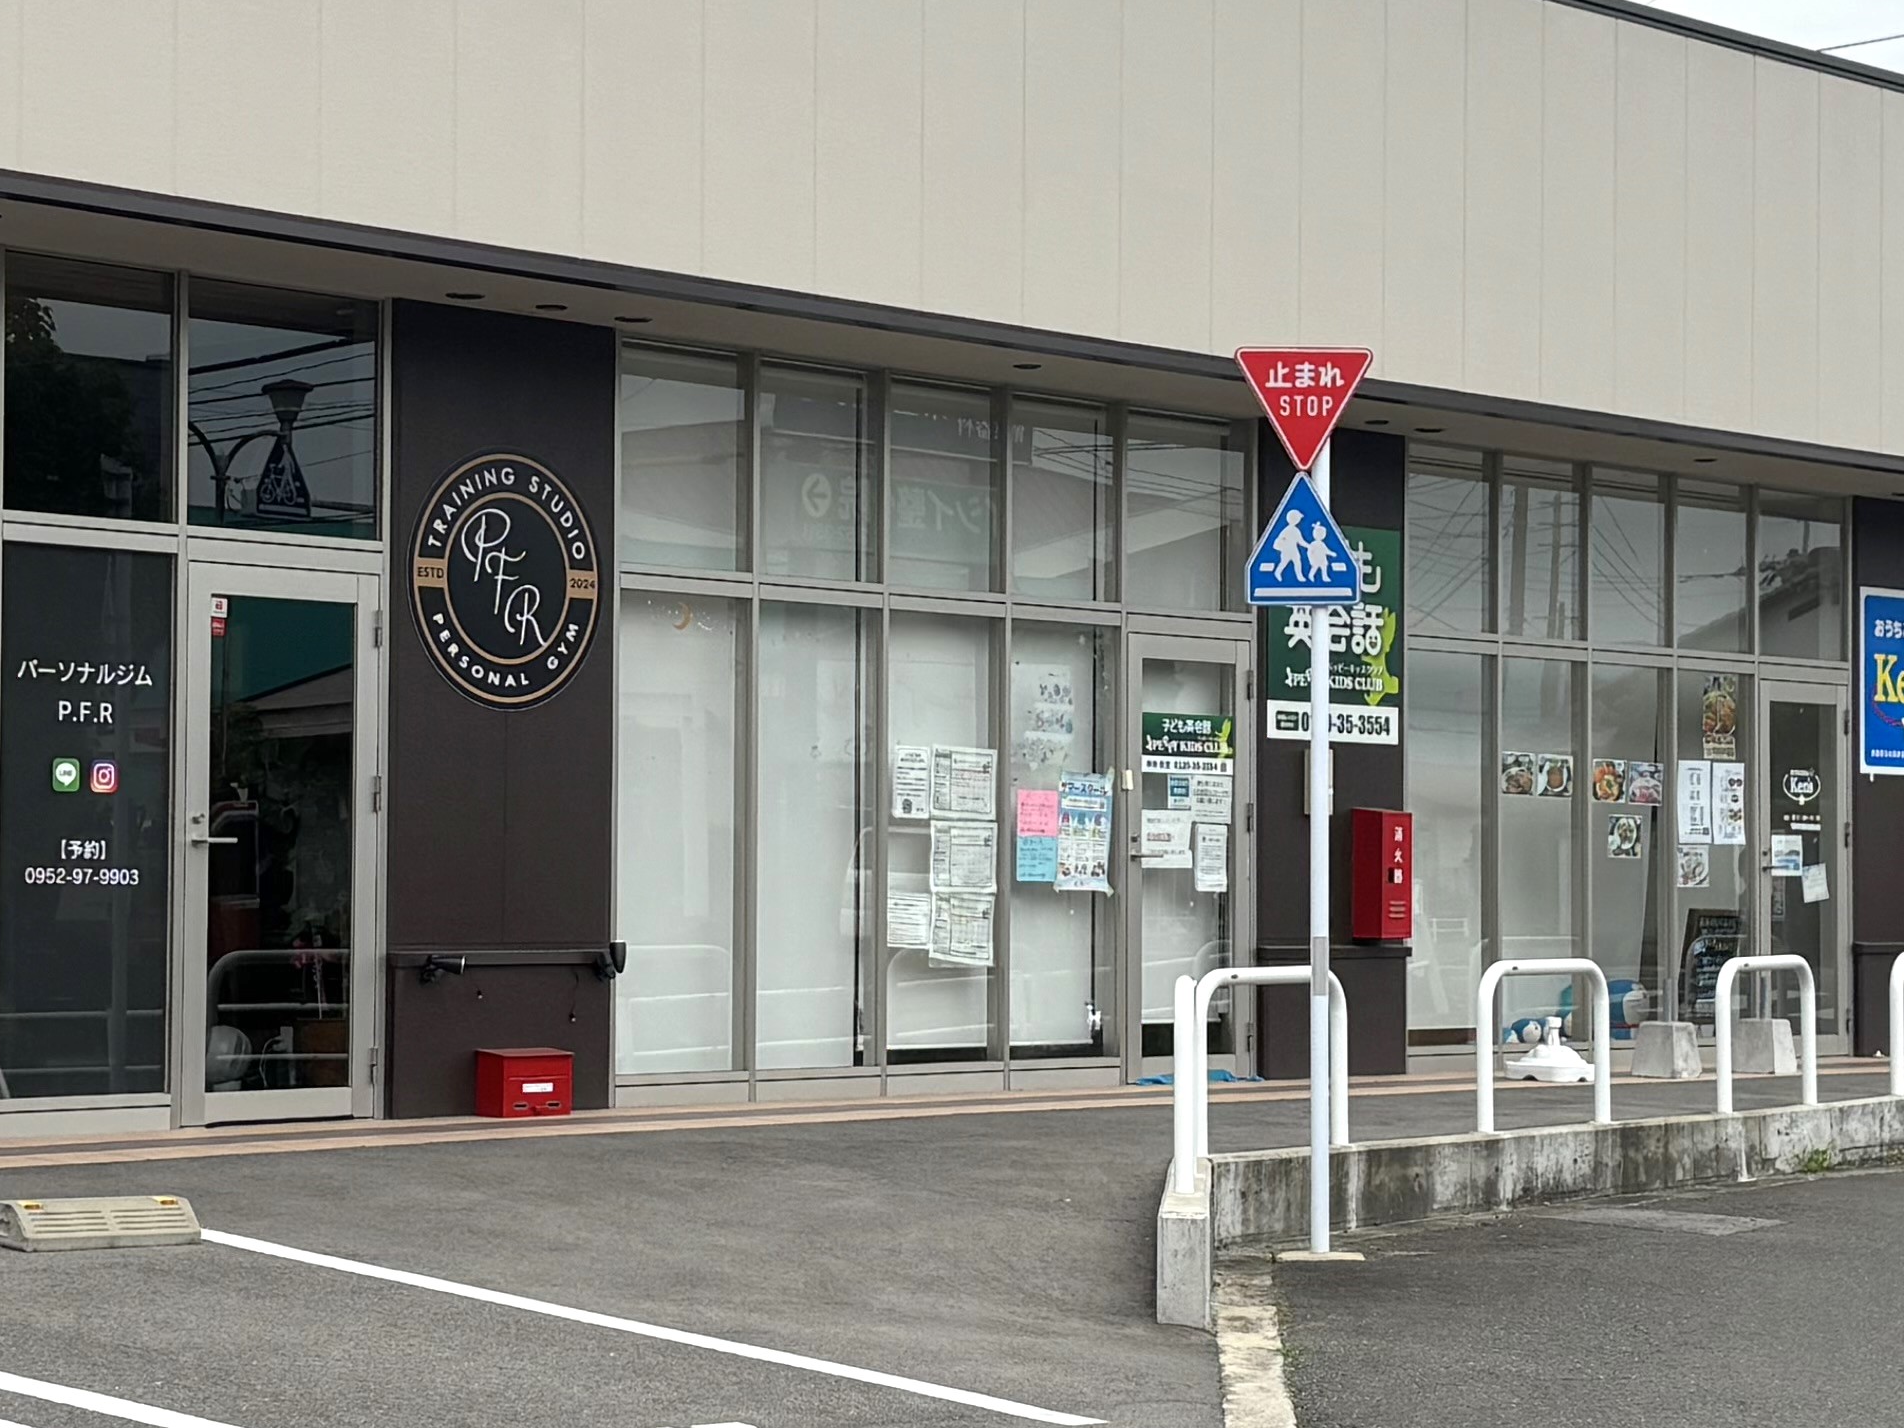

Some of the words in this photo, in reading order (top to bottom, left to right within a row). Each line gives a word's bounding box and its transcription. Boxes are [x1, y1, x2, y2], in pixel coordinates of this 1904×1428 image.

[1265, 361, 1344, 389] 止まれ
[1279, 395, 1333, 417] STOP
[428, 467, 515, 548] TRAINING
[529, 476, 585, 559] STUDIO
[417, 567, 444, 578] ESTD
[570, 577, 596, 589] 2024
[433, 612, 530, 687] PERSONAL
[547, 623, 579, 669] GYM
[17, 659, 153, 686] パーソナルジム
[1355, 677, 1383, 691] CLUB
[58, 701, 113, 723] P.F.R
[1301, 711, 1390, 736] 0-35-3554
[24, 867, 140, 886] 0952-97-9903
